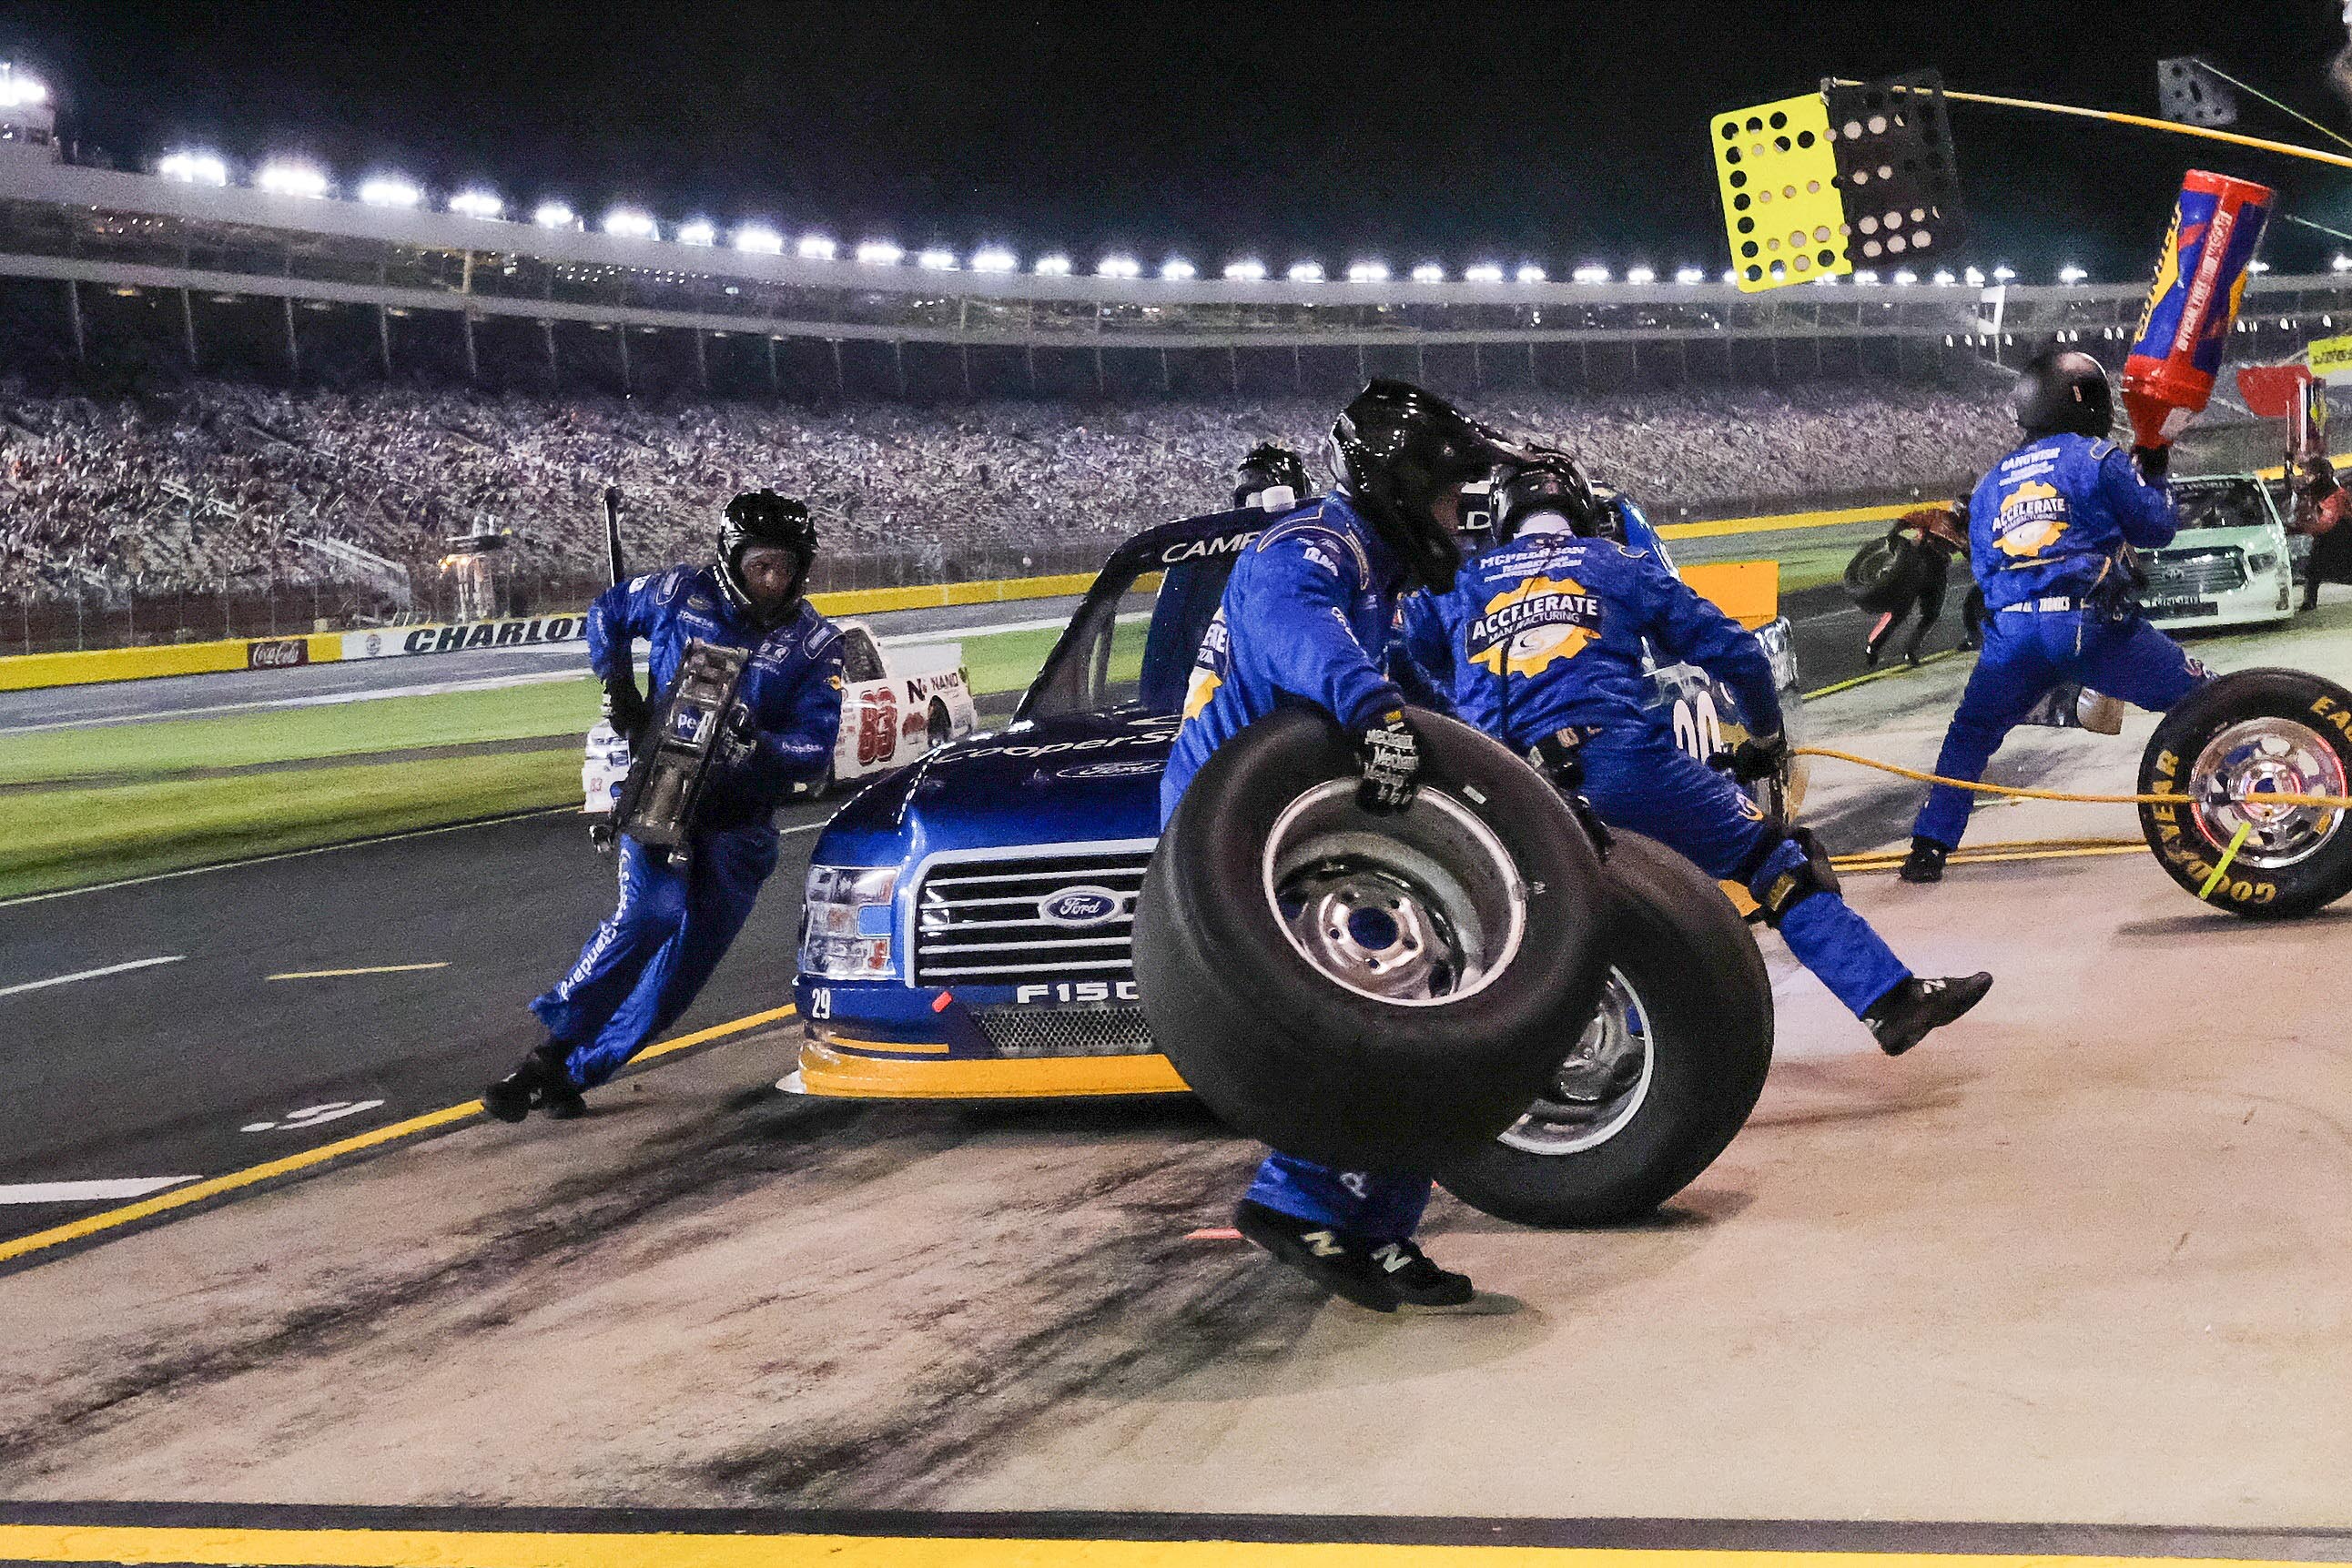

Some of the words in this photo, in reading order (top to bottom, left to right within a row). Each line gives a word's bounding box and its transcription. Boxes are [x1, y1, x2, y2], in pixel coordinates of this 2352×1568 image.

[1473, 595, 1597, 640] ACCELERATE
[1059, 897, 1101, 916] Ford
[812, 987, 831, 1019] 29
